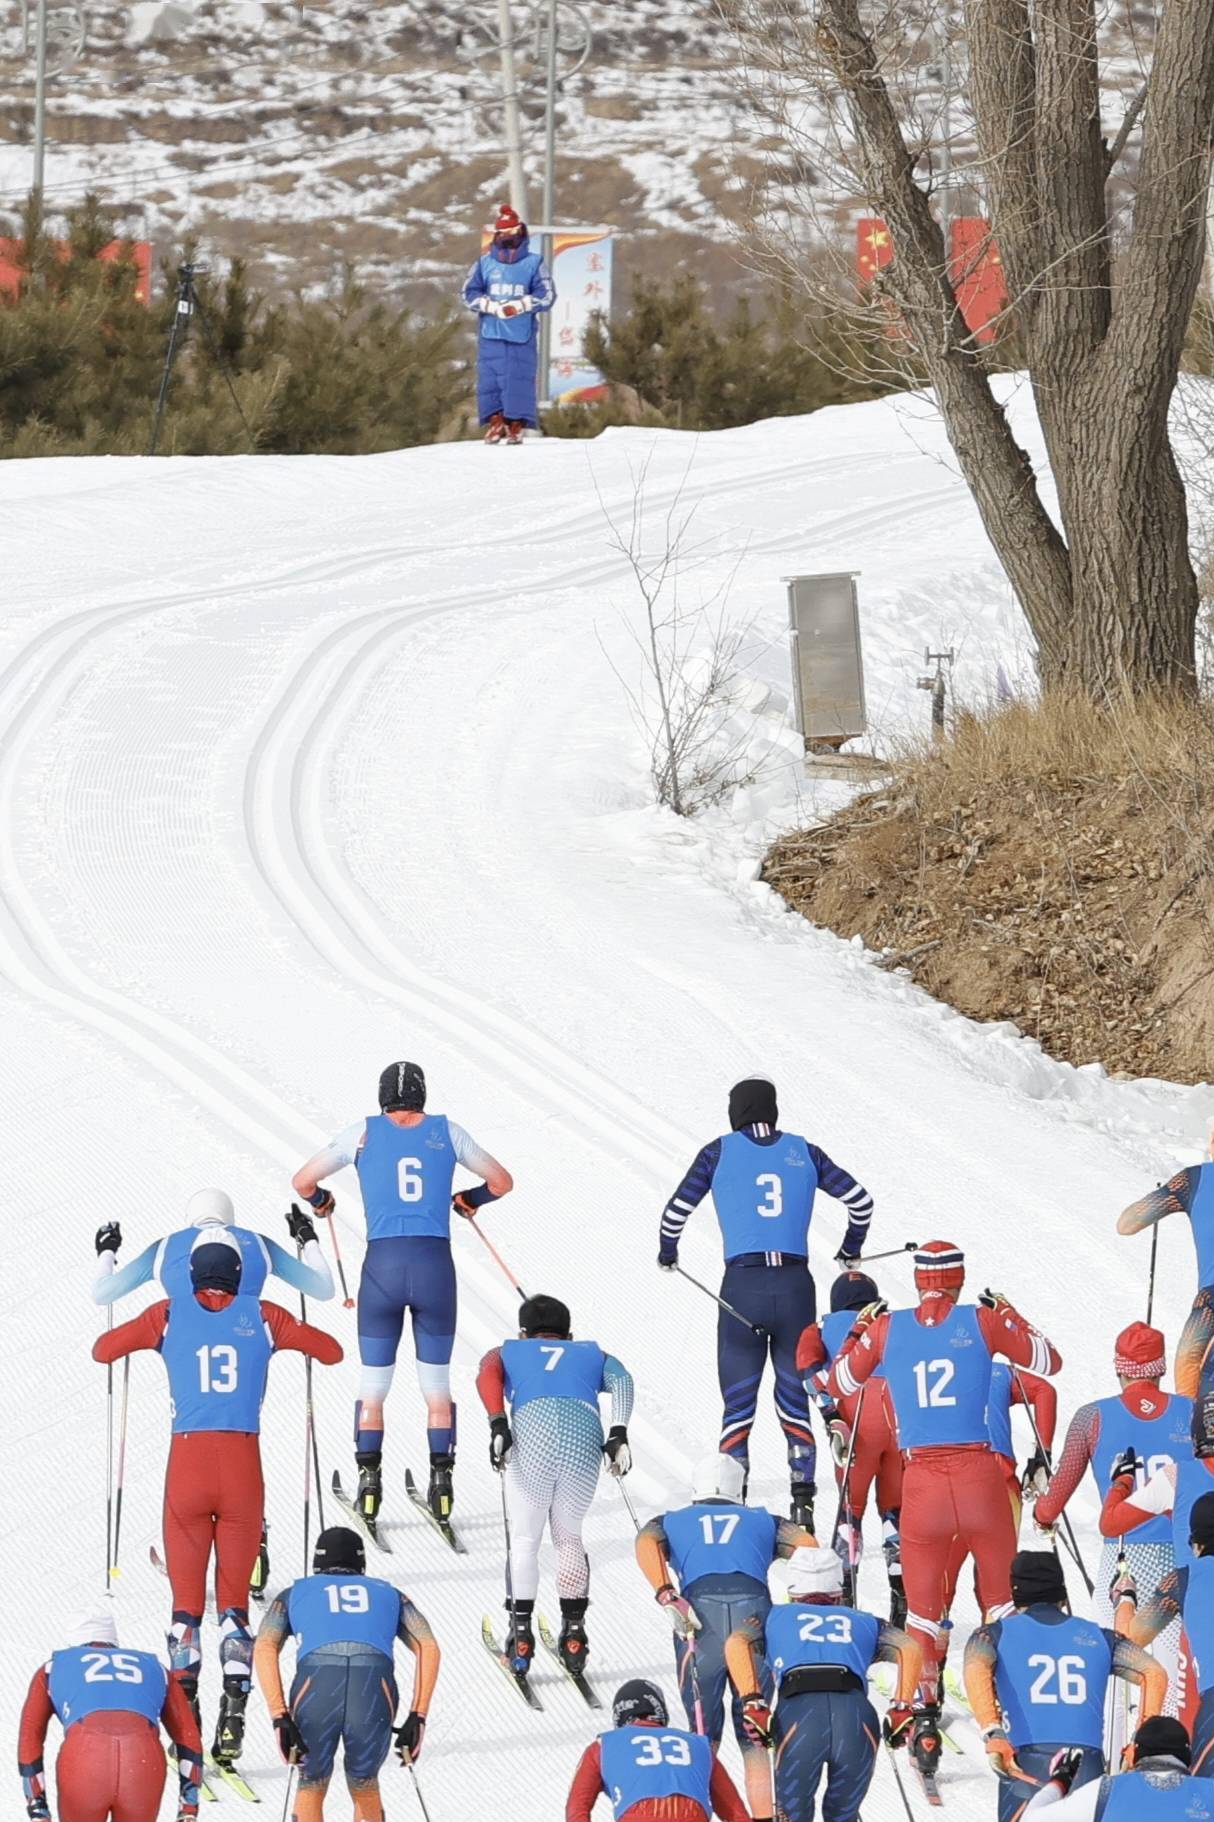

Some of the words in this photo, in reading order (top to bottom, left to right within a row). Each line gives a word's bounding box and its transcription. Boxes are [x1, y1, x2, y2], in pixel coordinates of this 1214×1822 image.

[398, 1158, 422, 1201] 6
[757, 1174, 782, 1217] 3
[196, 1345, 237, 1392] 13
[541, 1347, 564, 1370] 7
[913, 1359, 956, 1407] 12
[699, 1514, 741, 1544] 17
[325, 1585, 368, 1612] 19
[798, 1614, 851, 1643] 23
[81, 1654, 143, 1683] 25
[1029, 1655, 1086, 1704] 26
[632, 1736, 690, 1765] 33
